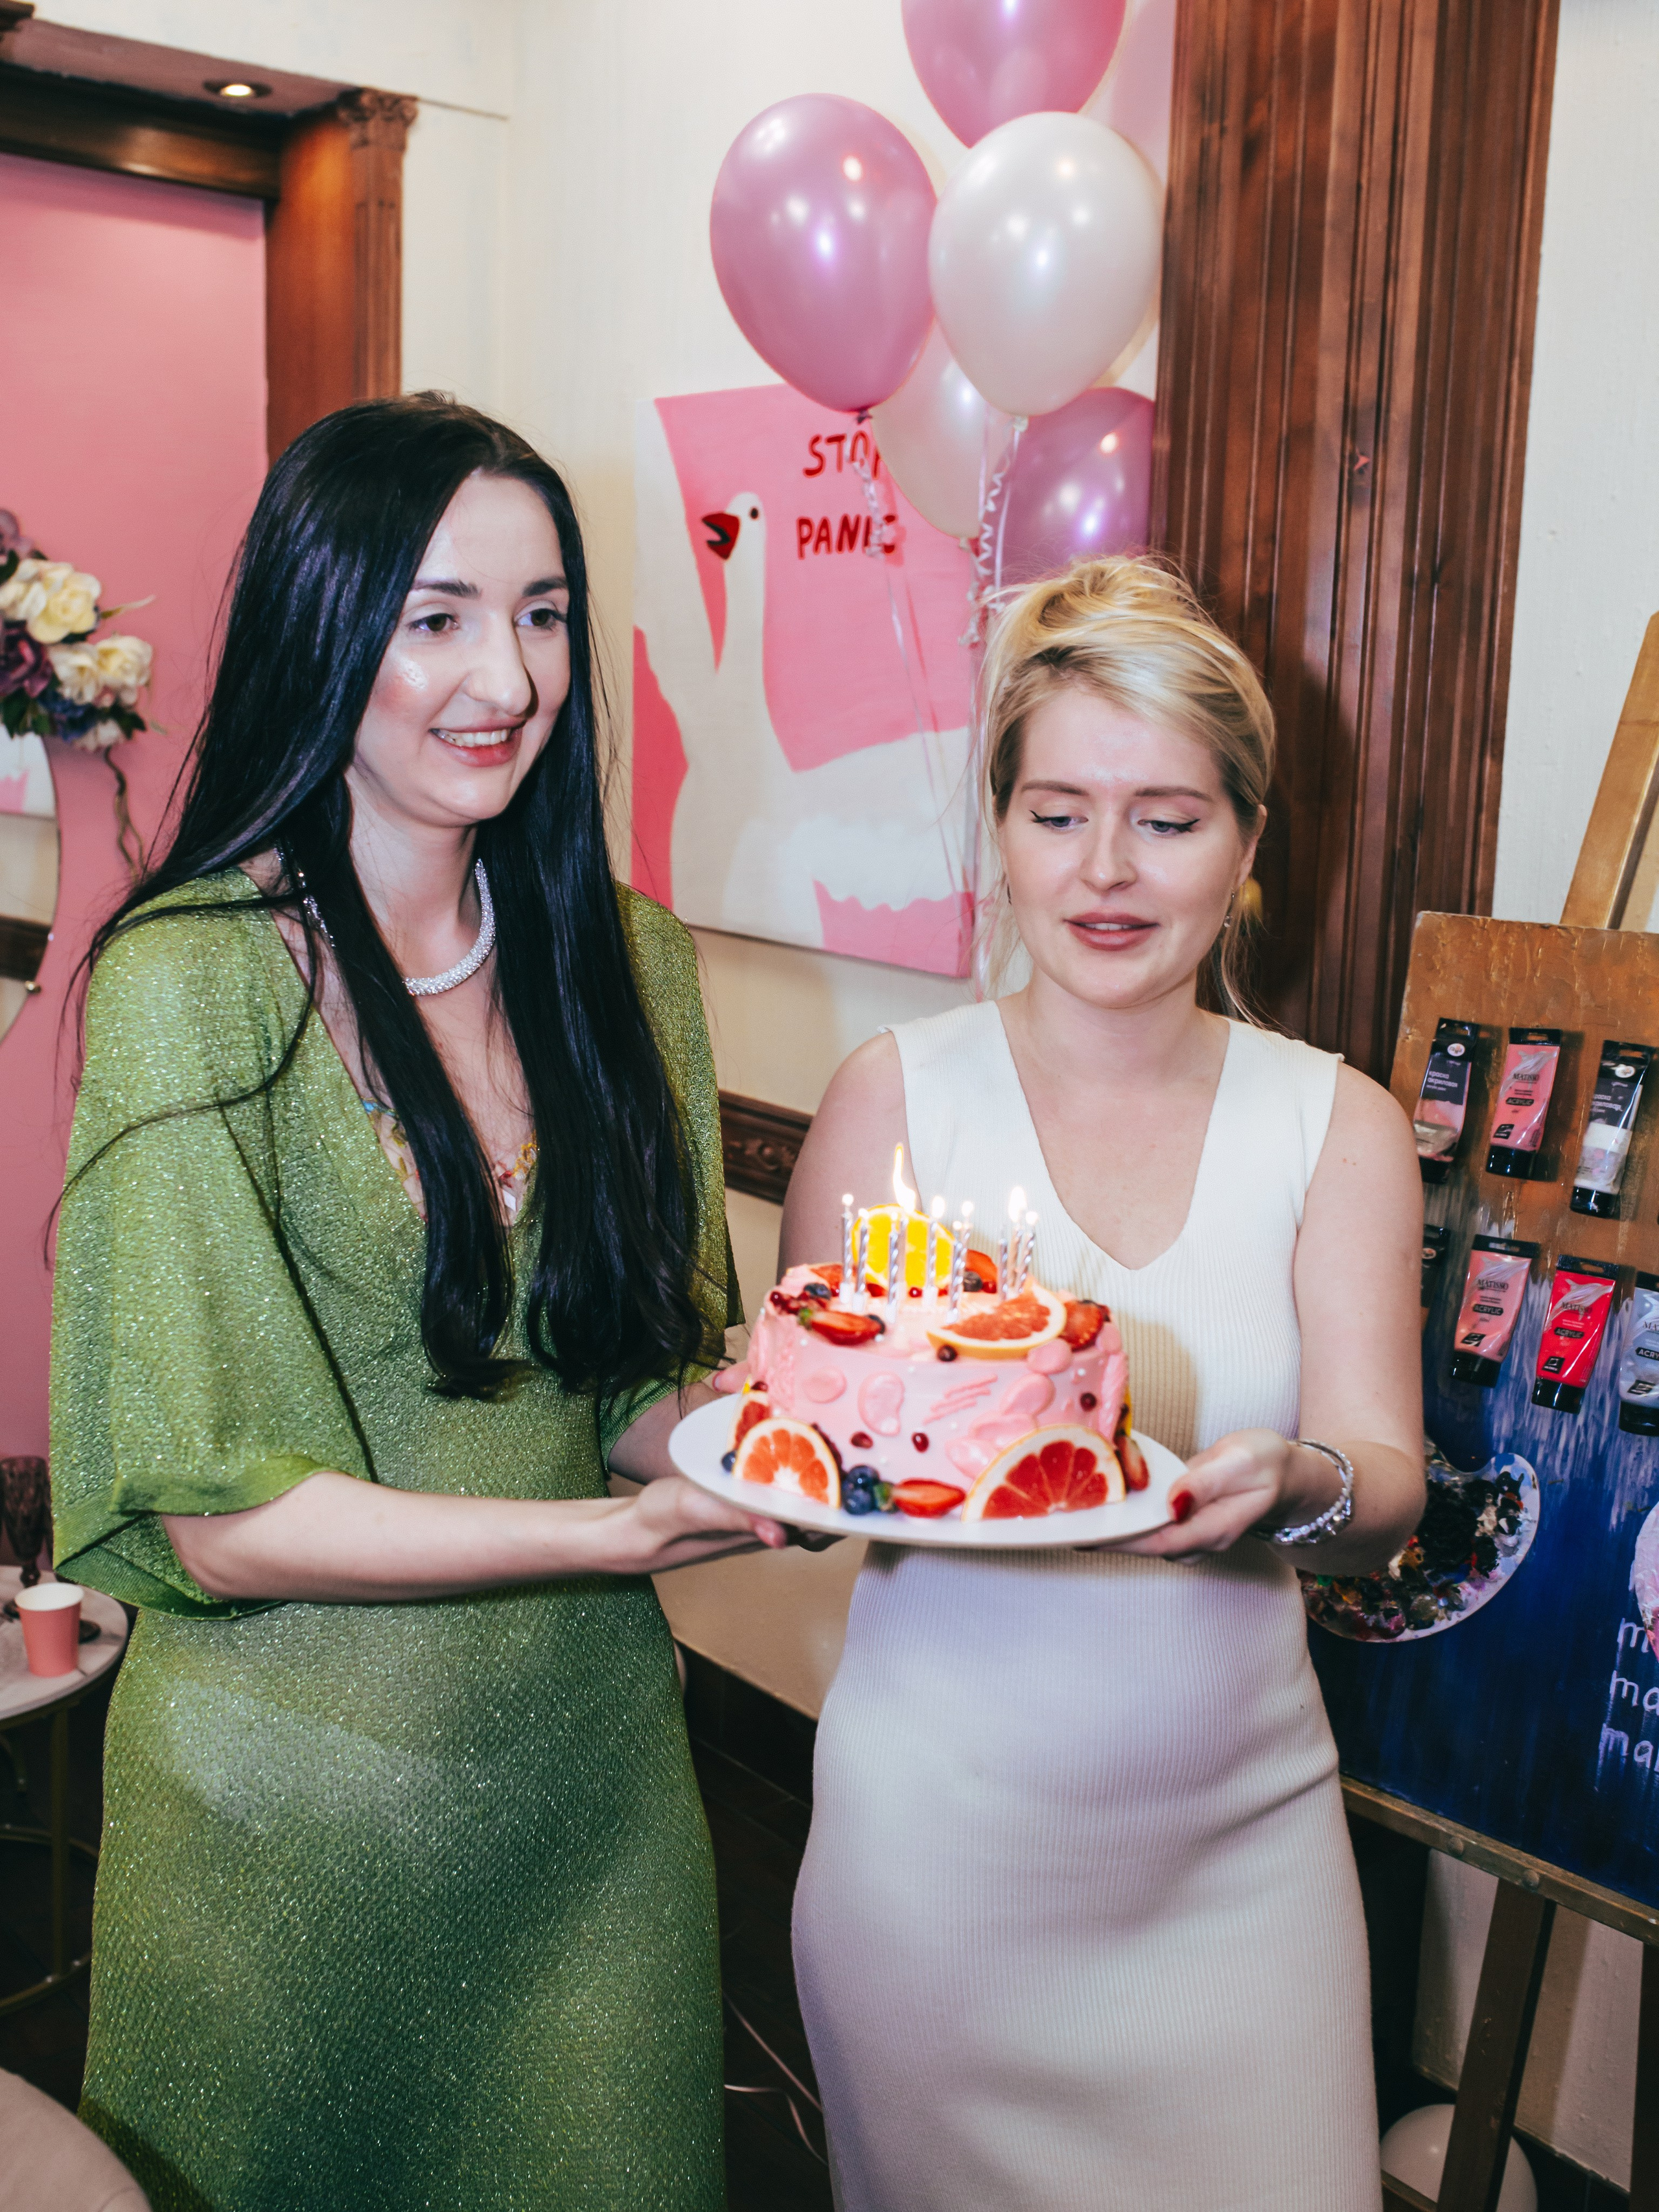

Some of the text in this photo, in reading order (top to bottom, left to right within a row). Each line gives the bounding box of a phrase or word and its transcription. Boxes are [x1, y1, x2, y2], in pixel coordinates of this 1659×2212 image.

[1477, 1279, 1509, 1290] MATISSO
[1474, 1305, 1502, 1314] ACRYLIC
[1643, 1321, 1659, 1331] MA
[1556, 1329, 1583, 1338] ACRYLIC
[1598, 1723, 1659, 1773] ma
